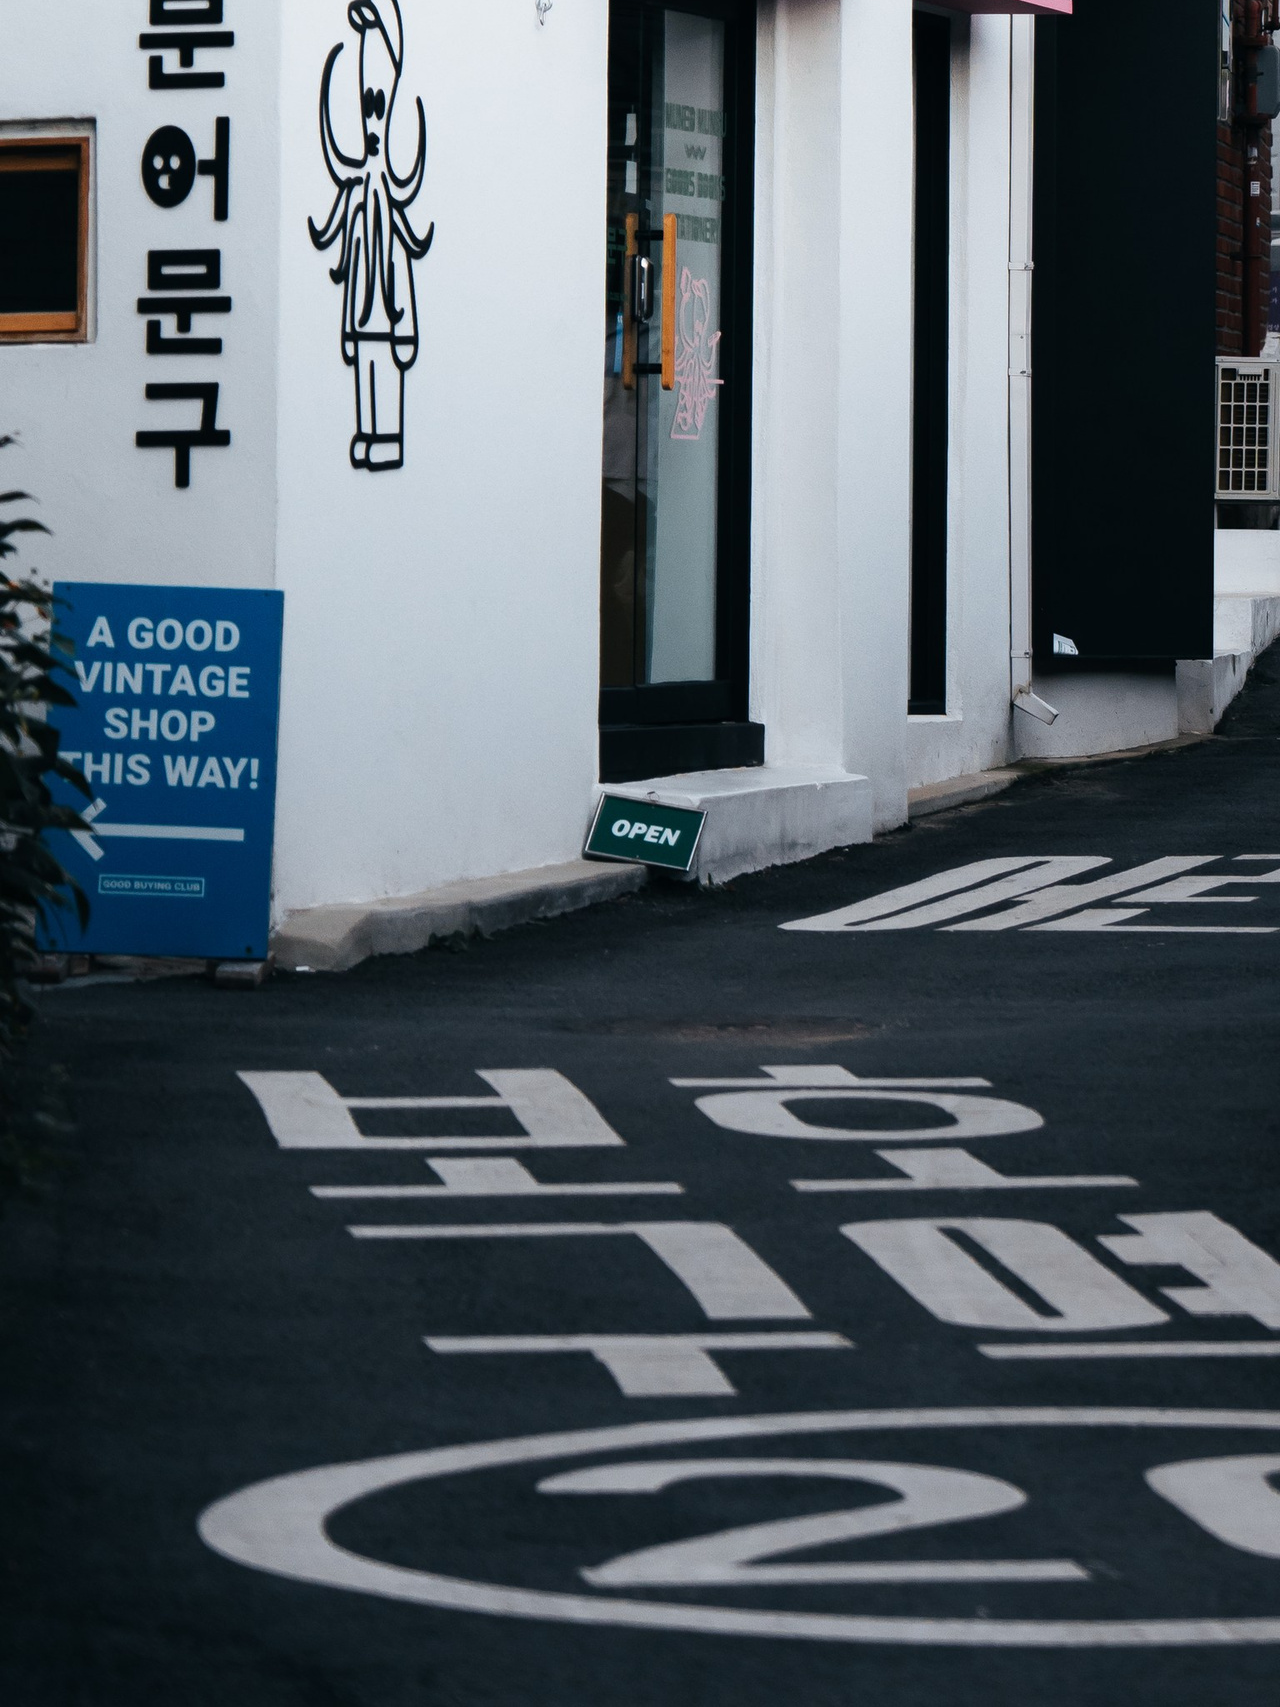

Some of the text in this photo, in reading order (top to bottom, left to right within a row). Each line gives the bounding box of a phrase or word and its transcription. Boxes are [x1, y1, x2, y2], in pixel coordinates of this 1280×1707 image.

[86, 616, 240, 652] A GOOD
[74, 660, 251, 698] VINTAGE
[104, 707, 216, 742] SHOP
[163, 755, 259, 790] WAY!
[611, 819, 681, 846] OPEN
[103, 880, 201, 892] GOOD BUYING CLUB
